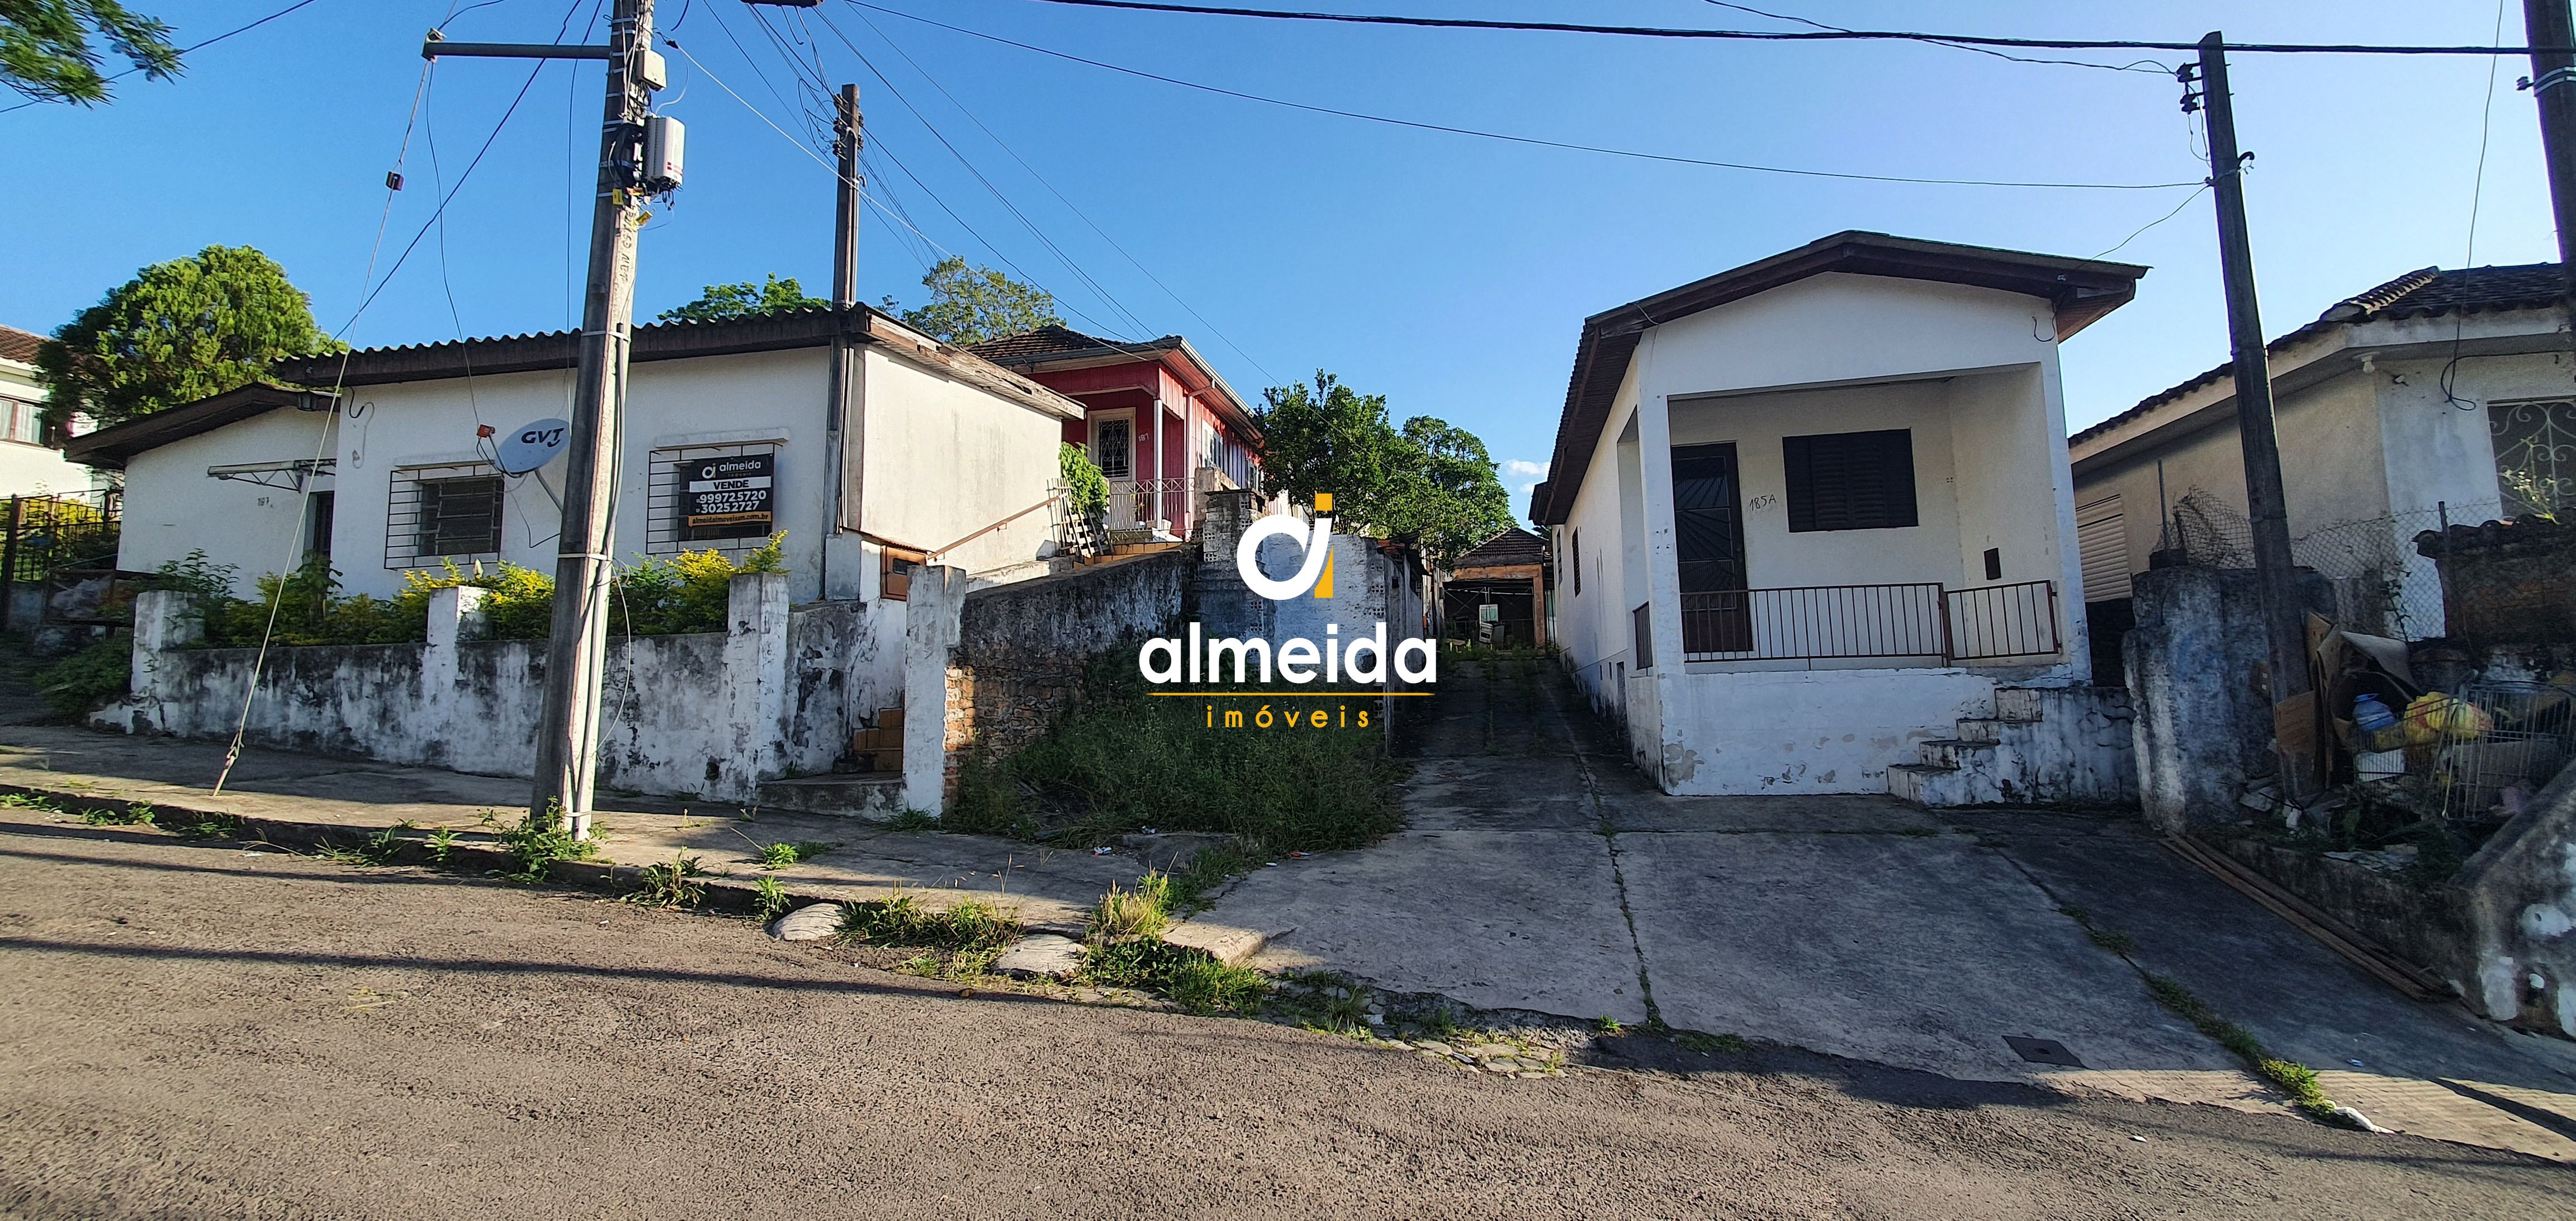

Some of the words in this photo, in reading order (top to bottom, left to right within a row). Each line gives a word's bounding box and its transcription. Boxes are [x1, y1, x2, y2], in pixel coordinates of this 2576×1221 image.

[521, 427, 564, 448] GVT
[1138, 433, 1149, 442] 187
[719, 460, 761, 472] almeida
[713, 480, 749, 490] VENDE
[1749, 494, 1777, 512] 185A
